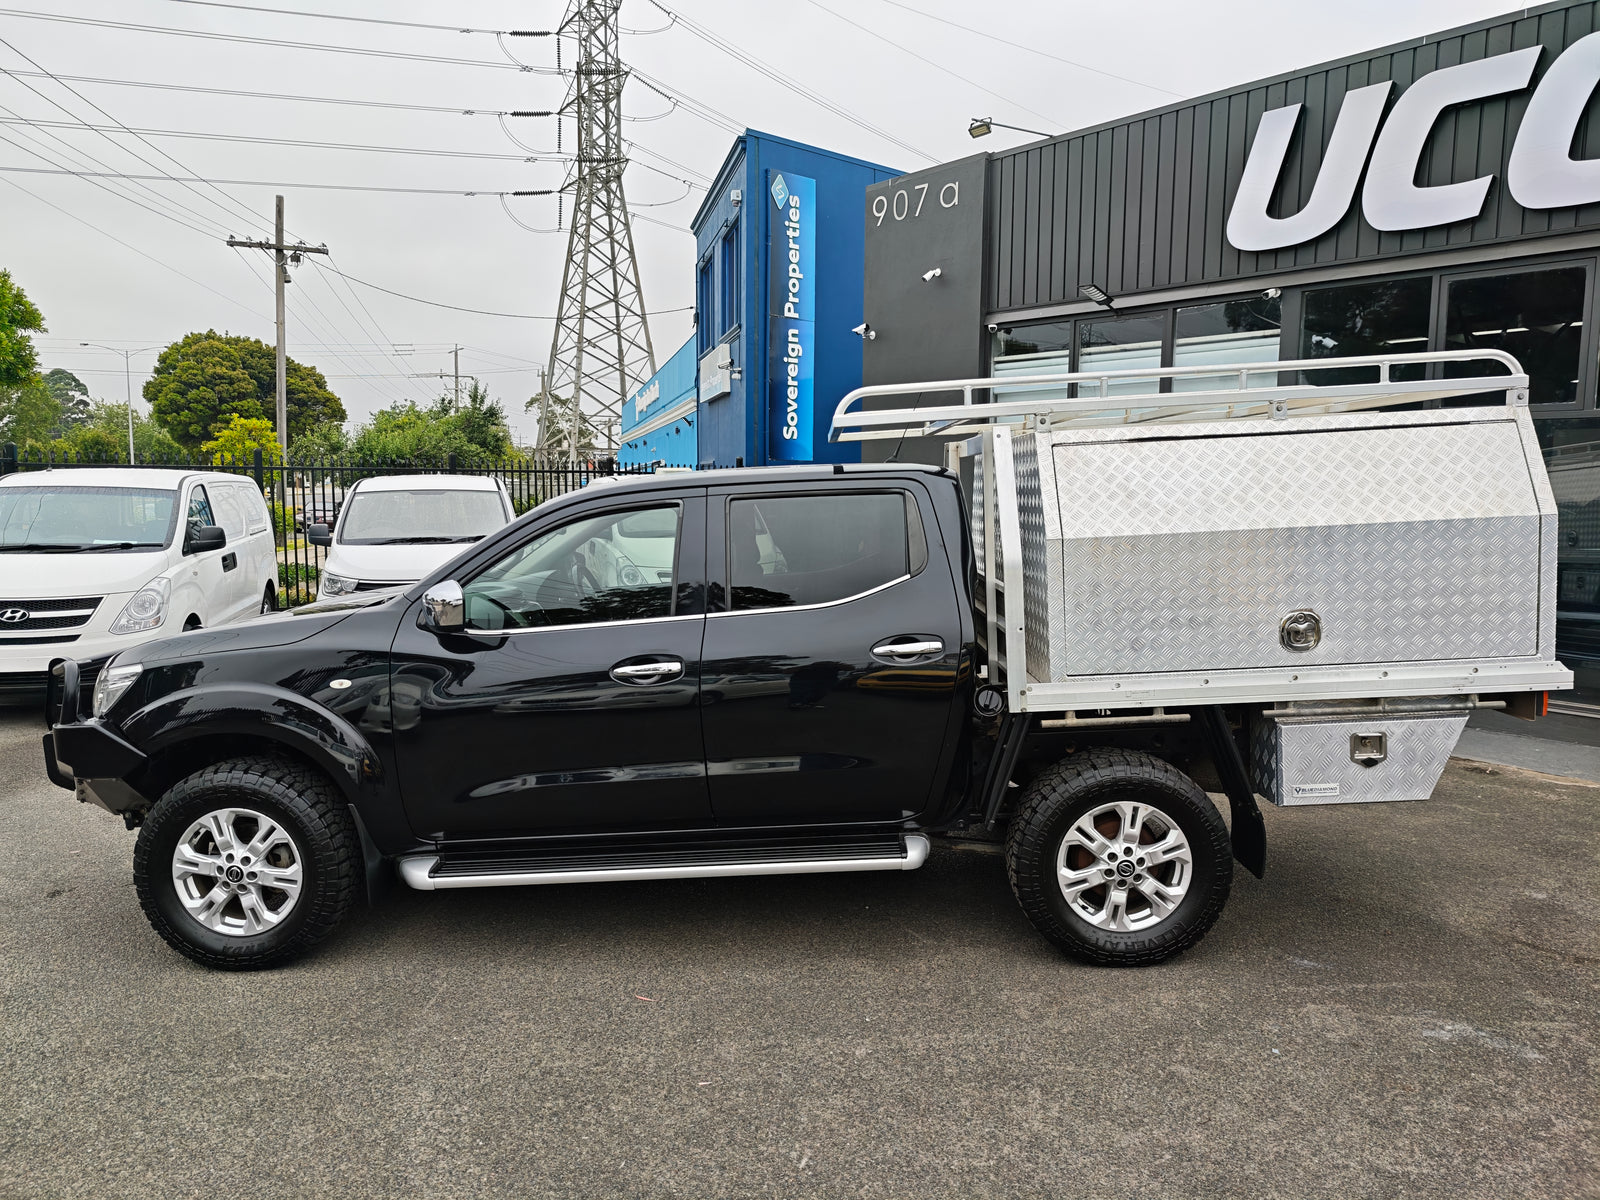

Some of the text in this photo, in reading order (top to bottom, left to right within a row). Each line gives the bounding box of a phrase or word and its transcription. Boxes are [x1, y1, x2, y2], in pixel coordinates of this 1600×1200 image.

[872, 181, 959, 227] 907 a
[783, 195, 804, 440] Sovereign Properties
